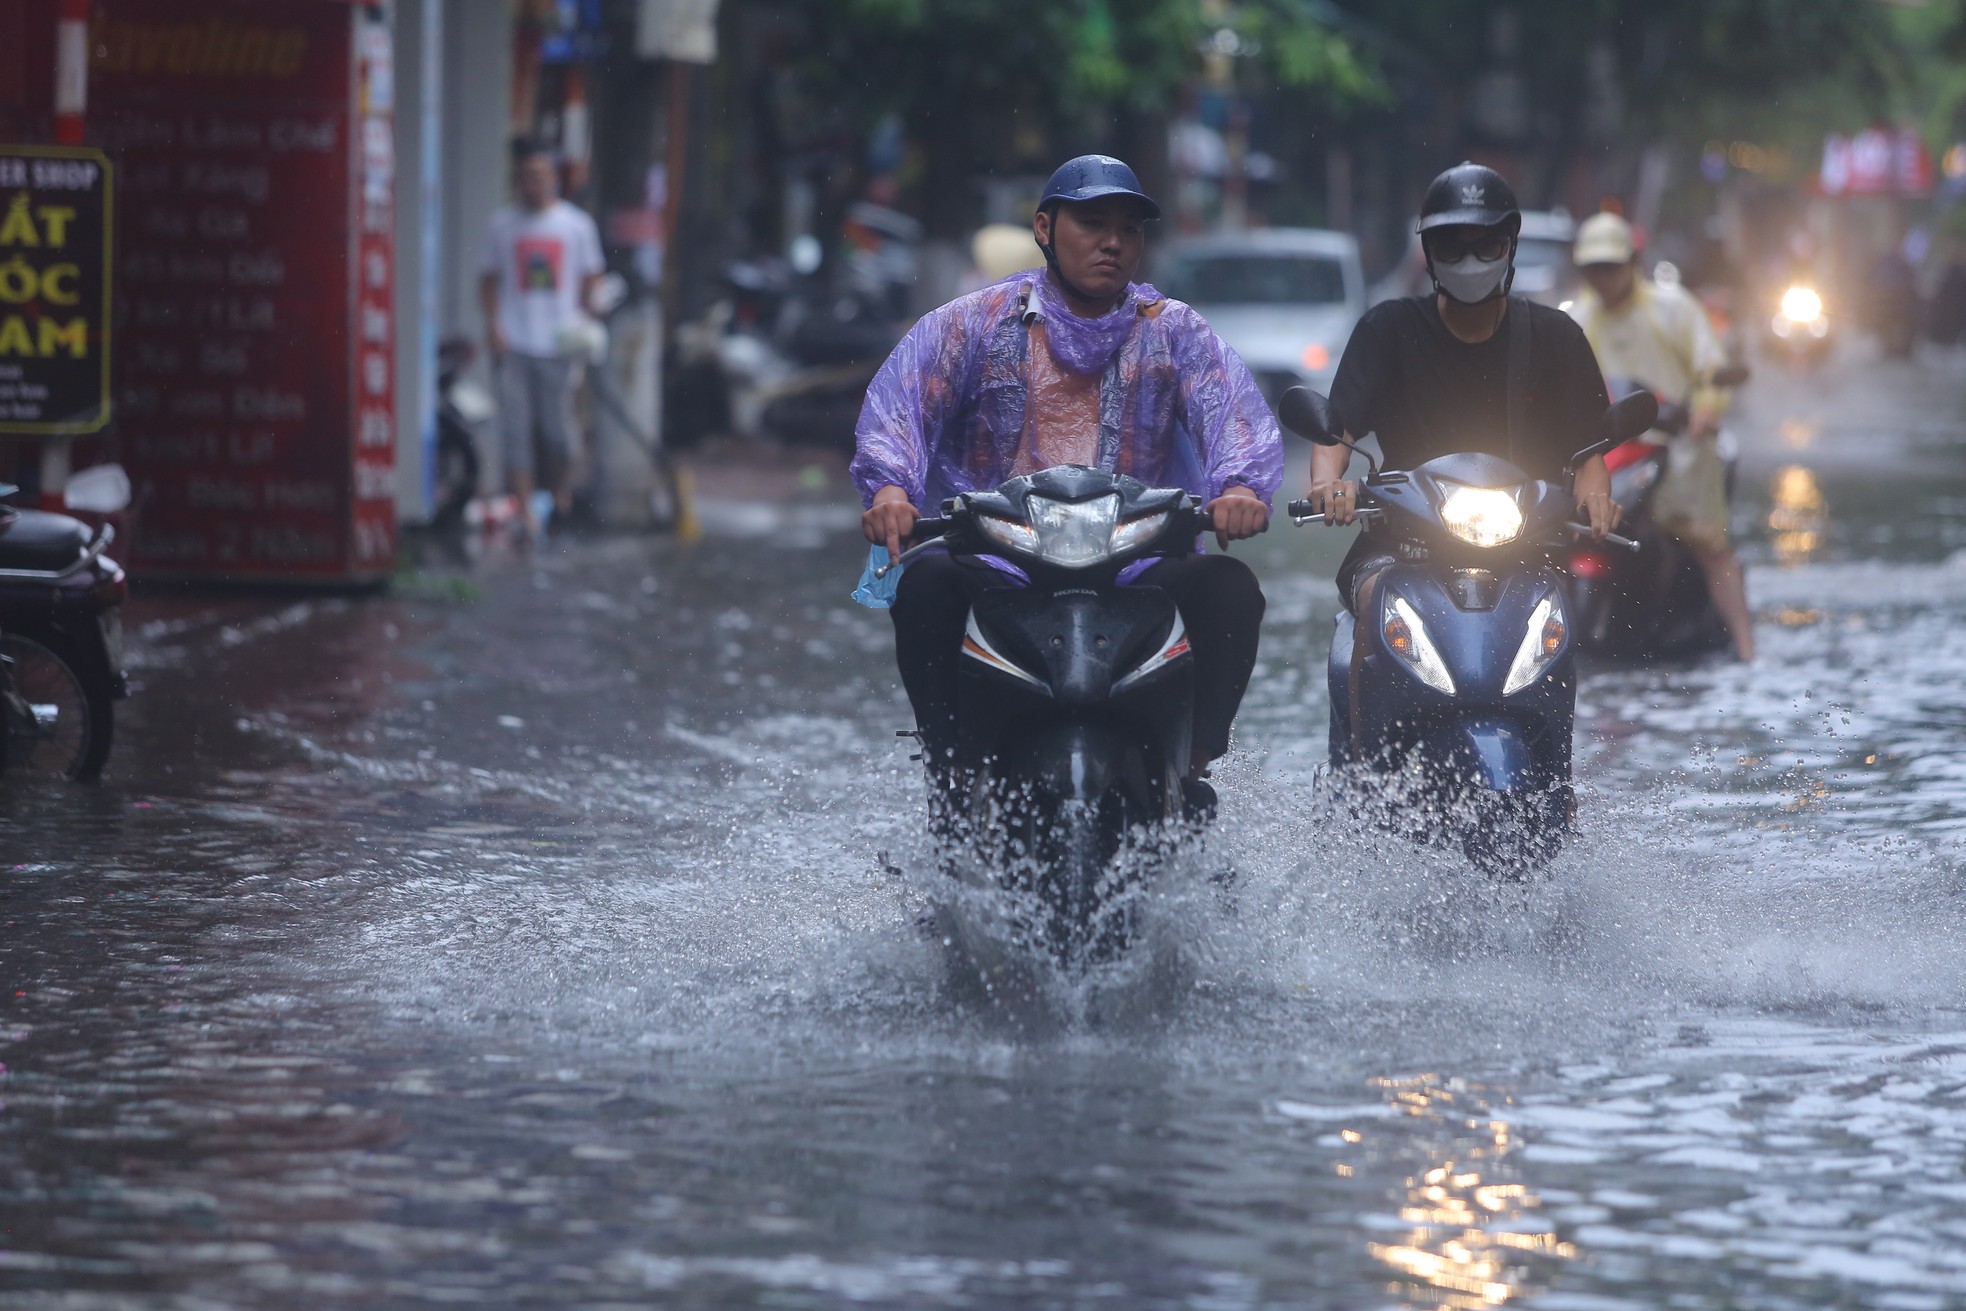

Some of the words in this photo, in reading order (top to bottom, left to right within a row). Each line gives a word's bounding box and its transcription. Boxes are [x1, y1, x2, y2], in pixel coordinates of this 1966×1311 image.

[31, 159, 99, 191] SHOP
[0, 315, 88, 358] AM
[1053, 588, 1098, 597] HONDA
